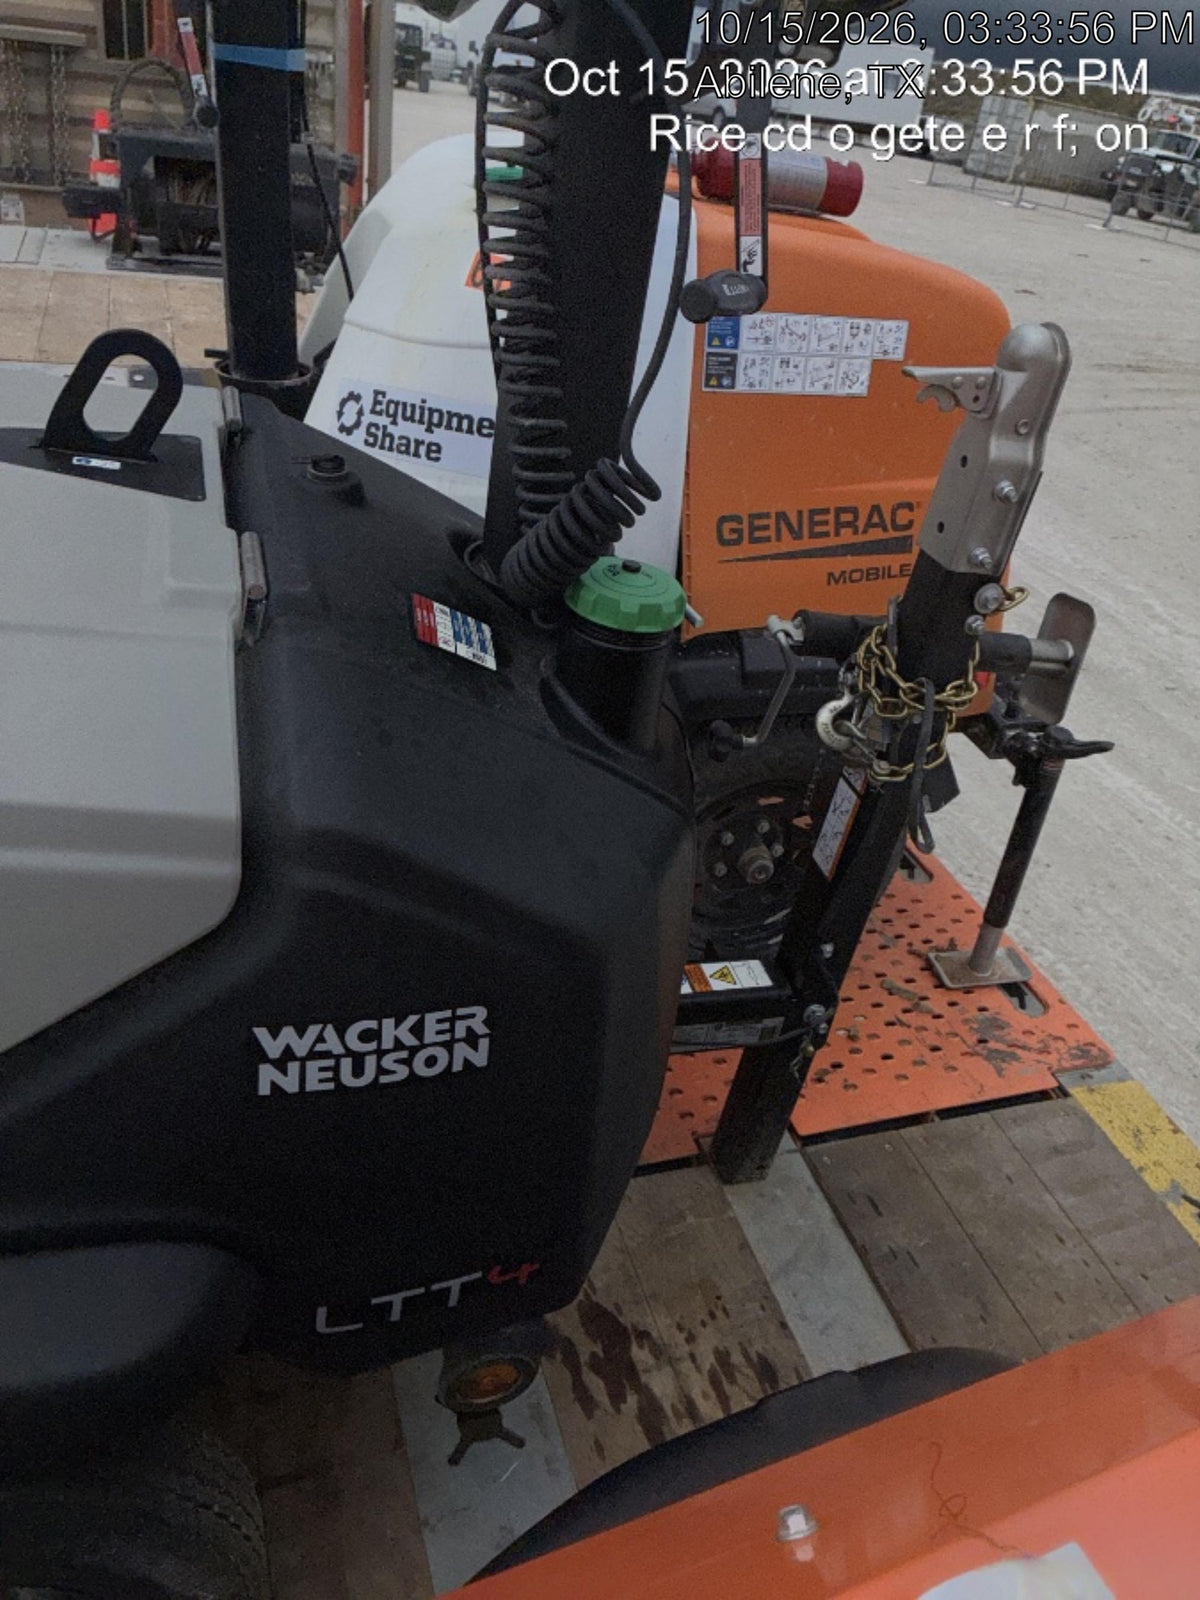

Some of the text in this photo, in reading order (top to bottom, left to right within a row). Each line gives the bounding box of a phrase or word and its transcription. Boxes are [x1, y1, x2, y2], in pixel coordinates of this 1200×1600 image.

[368, 388, 496, 439] Equipme
[363, 420, 443, 463] Share
[715, 501, 915, 547] GENERAC
[826, 562, 912, 586] MOBILE
[251, 1005, 491, 1060] WACKER
[257, 1037, 490, 1096] NEUSON
